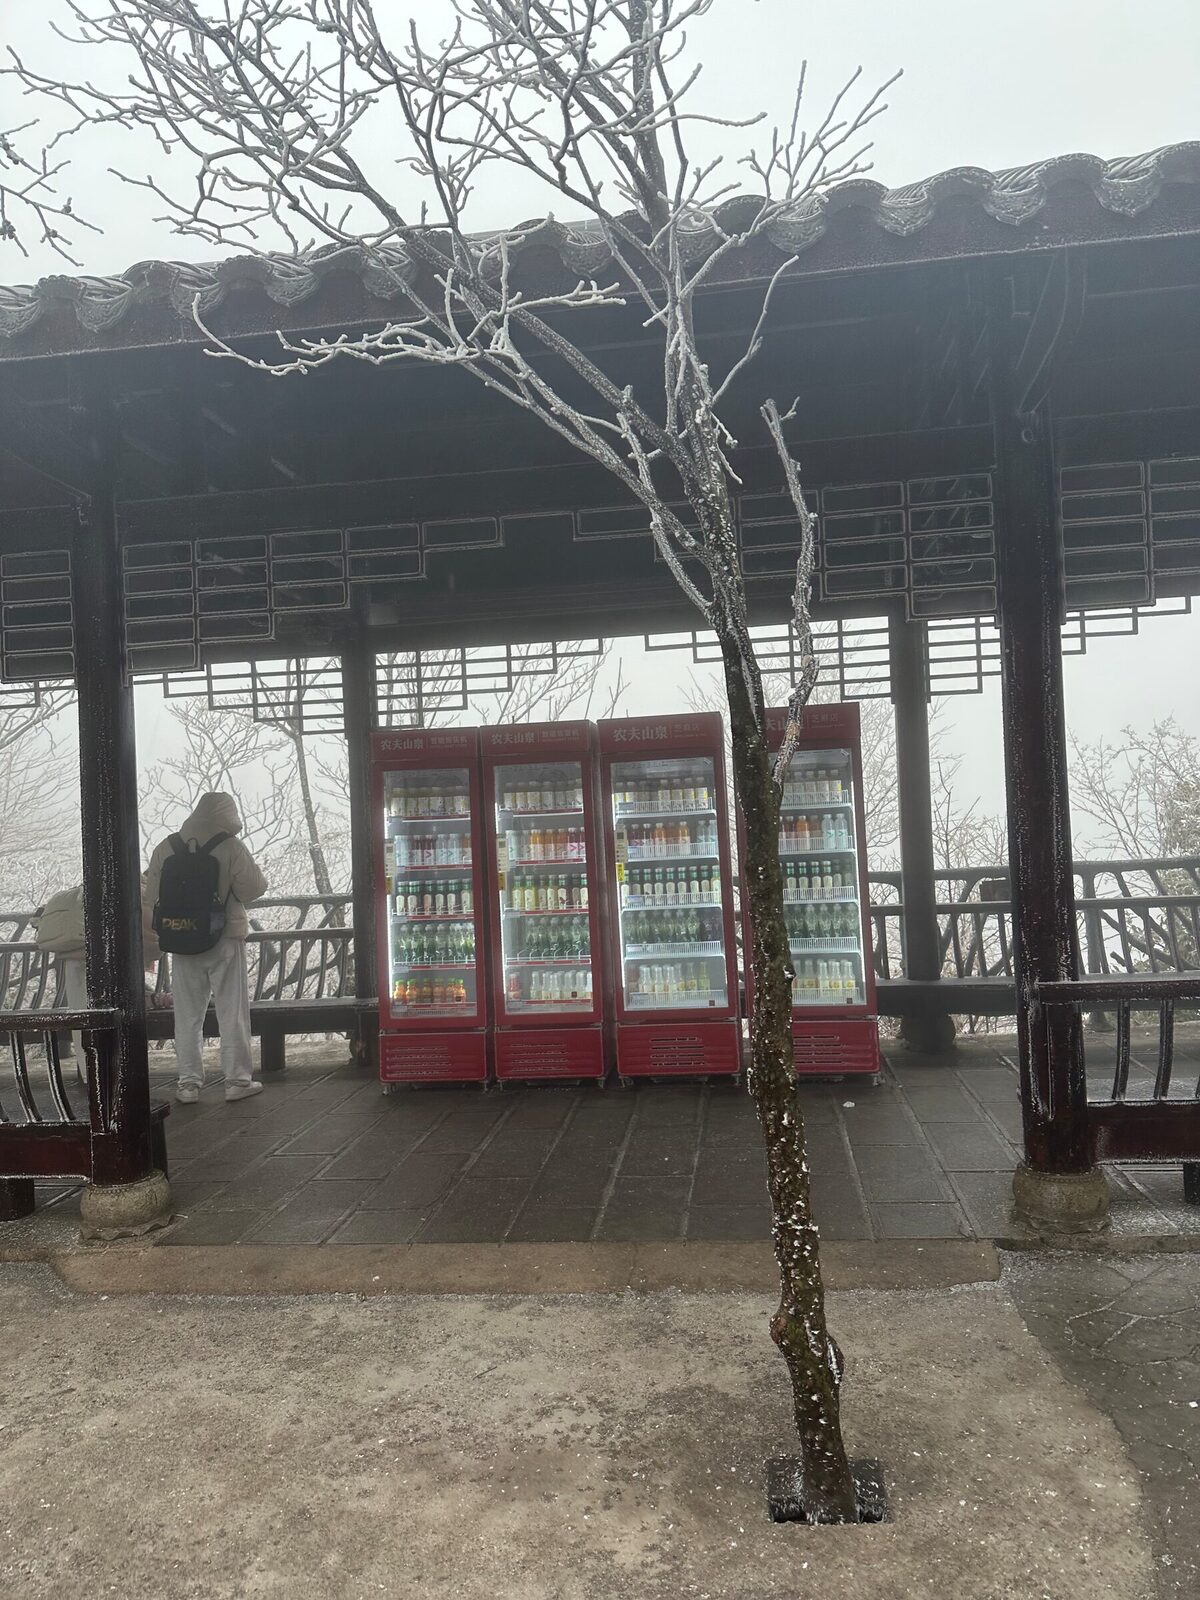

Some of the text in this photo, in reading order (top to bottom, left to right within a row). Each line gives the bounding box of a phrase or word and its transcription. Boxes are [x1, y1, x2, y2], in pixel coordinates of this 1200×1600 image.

[491, 731, 537, 745] 农夫山泉
[612, 725, 668, 742] 农夫山泉
[380, 738, 424, 751] 农夫山泉
[162, 918, 198, 931] PEAK
